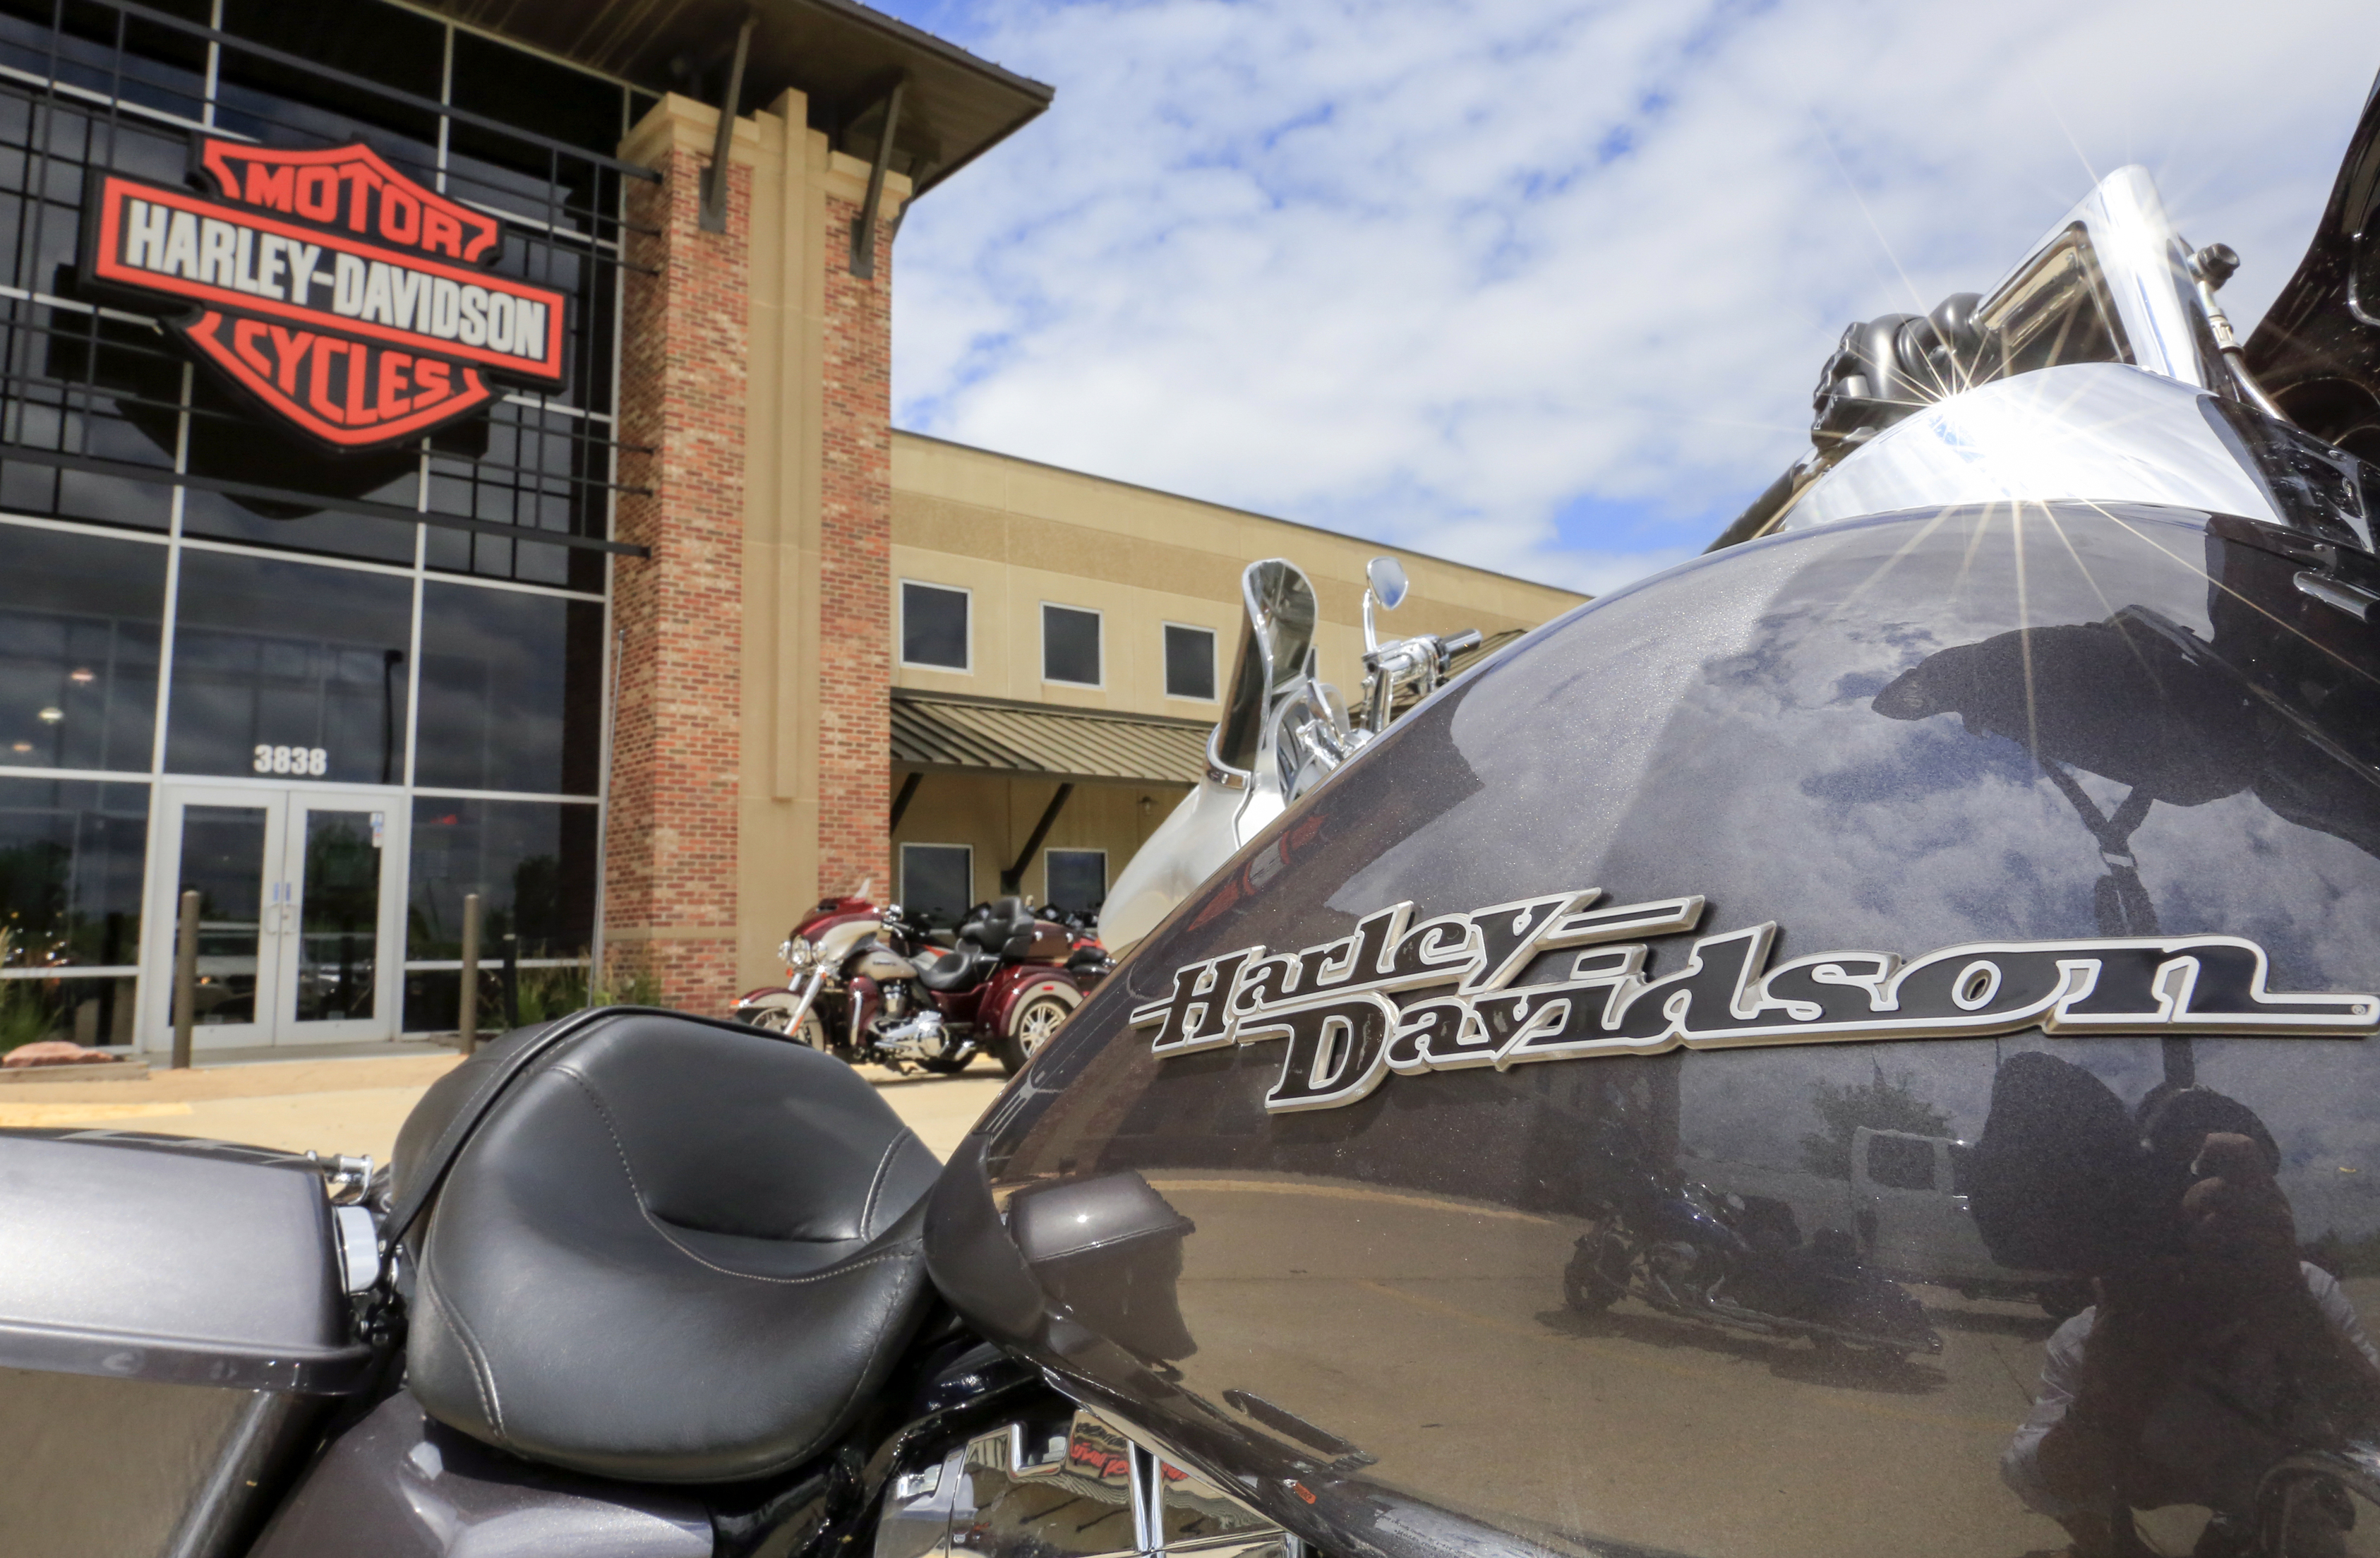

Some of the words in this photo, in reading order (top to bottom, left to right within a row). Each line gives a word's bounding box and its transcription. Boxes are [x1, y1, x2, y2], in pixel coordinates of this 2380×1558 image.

[245, 162, 463, 258] MOTOR
[126, 199, 546, 360] HARLEY-DAVIDSON
[234, 320, 454, 424] CYCLES
[253, 744, 327, 776] 3838
[1131, 887, 1705, 1059] Harley
[1237, 920, 2379, 1114] Davidson
